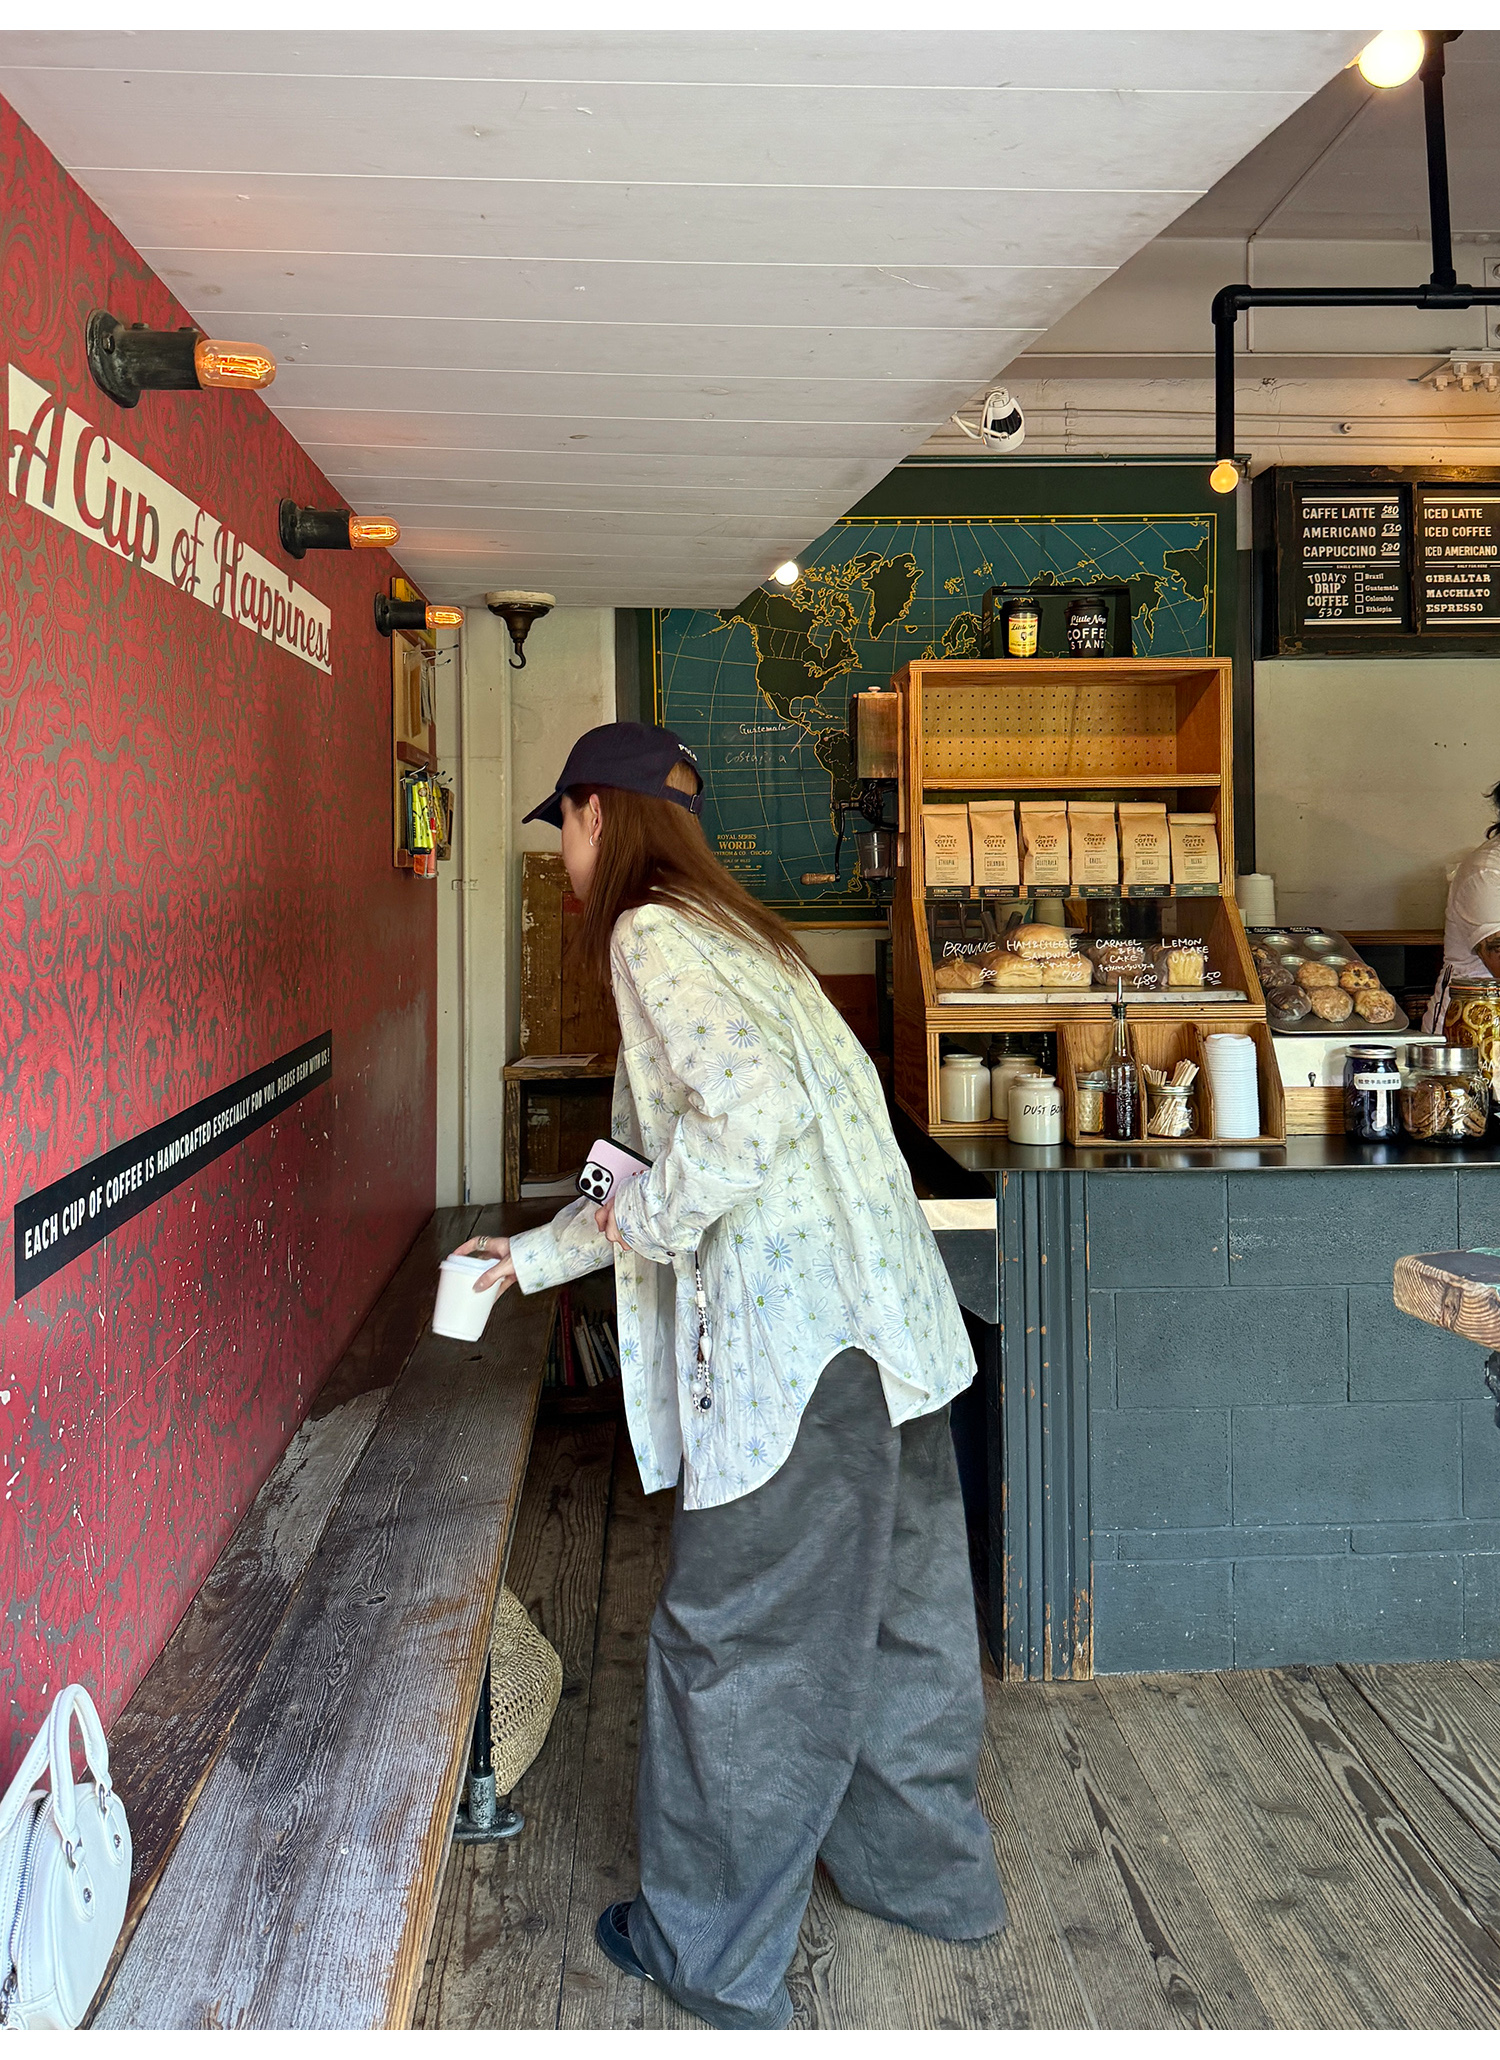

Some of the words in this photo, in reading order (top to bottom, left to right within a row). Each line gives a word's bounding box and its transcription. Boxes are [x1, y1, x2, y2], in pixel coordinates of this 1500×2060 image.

[1302, 508, 1338, 519] CAFFE
[1341, 508, 1376, 519] LATTE
[1381, 505, 1400, 516] 580
[1424, 508, 1448, 519] ICED
[1452, 508, 1483, 519] LATTE
[9, 393, 66, 510] A
[74, 425, 159, 566] Cup
[171, 508, 205, 593] of
[213, 525, 331, 667] Happiness
[1302, 526, 1377, 538] AMERICANO
[1382, 523, 1402, 535] 530
[1424, 526, 1448, 537] ICED
[1452, 526, 1492, 537] COFFEE
[1303, 545, 1376, 557] CAPPUCCINO
[1425, 546, 1442, 556] ICED
[1444, 545, 1498, 556] AMERICANO
[1307, 572, 1347, 584] TODAY'S
[1425, 574, 1491, 583] GIBRALTAR
[1314, 583, 1341, 594] DRIP
[1426, 589, 1490, 598] MACCHIATO
[1307, 595, 1349, 607] COFFEE
[1318, 608, 1342, 618] 530
[1426, 603, 1483, 613] ESPRESSO
[1070, 614, 1091, 626] Little
[1071, 640, 1105, 650] STAND
[739, 723, 786, 735] Guatemala
[719, 841, 756, 850] WORLD
[942, 940, 996, 957] BROWNIE
[1095, 939, 1142, 949] CARAMEL
[1161, 938, 1202, 949] LEMON
[1181, 945, 1209, 954] CAKE
[1021, 951, 1081, 961] SANDWICH
[1109, 955, 1138, 963] CAKE
[979, 968, 997, 979] 500
[1133, 974, 1158, 988] 480
[1023, 1104, 1046, 1115] DUST
[24, 1213, 58, 1260] EACH
[62, 1197, 85, 1236] CUP
[89, 1185, 103, 1218] OF
[105, 1161, 143, 1208] COFFEE
[145, 1155, 155, 1182] IS
[157, 1120, 212, 1174] HANDCRAFTED
[213, 1096, 251, 1138] ESPECIALLY
[251, 1089, 262, 1113] FOR
[277, 1068, 296, 1096] PLEASE
[296, 1060, 309, 1084] BEAR
[309, 1053, 321, 1075] WITH
